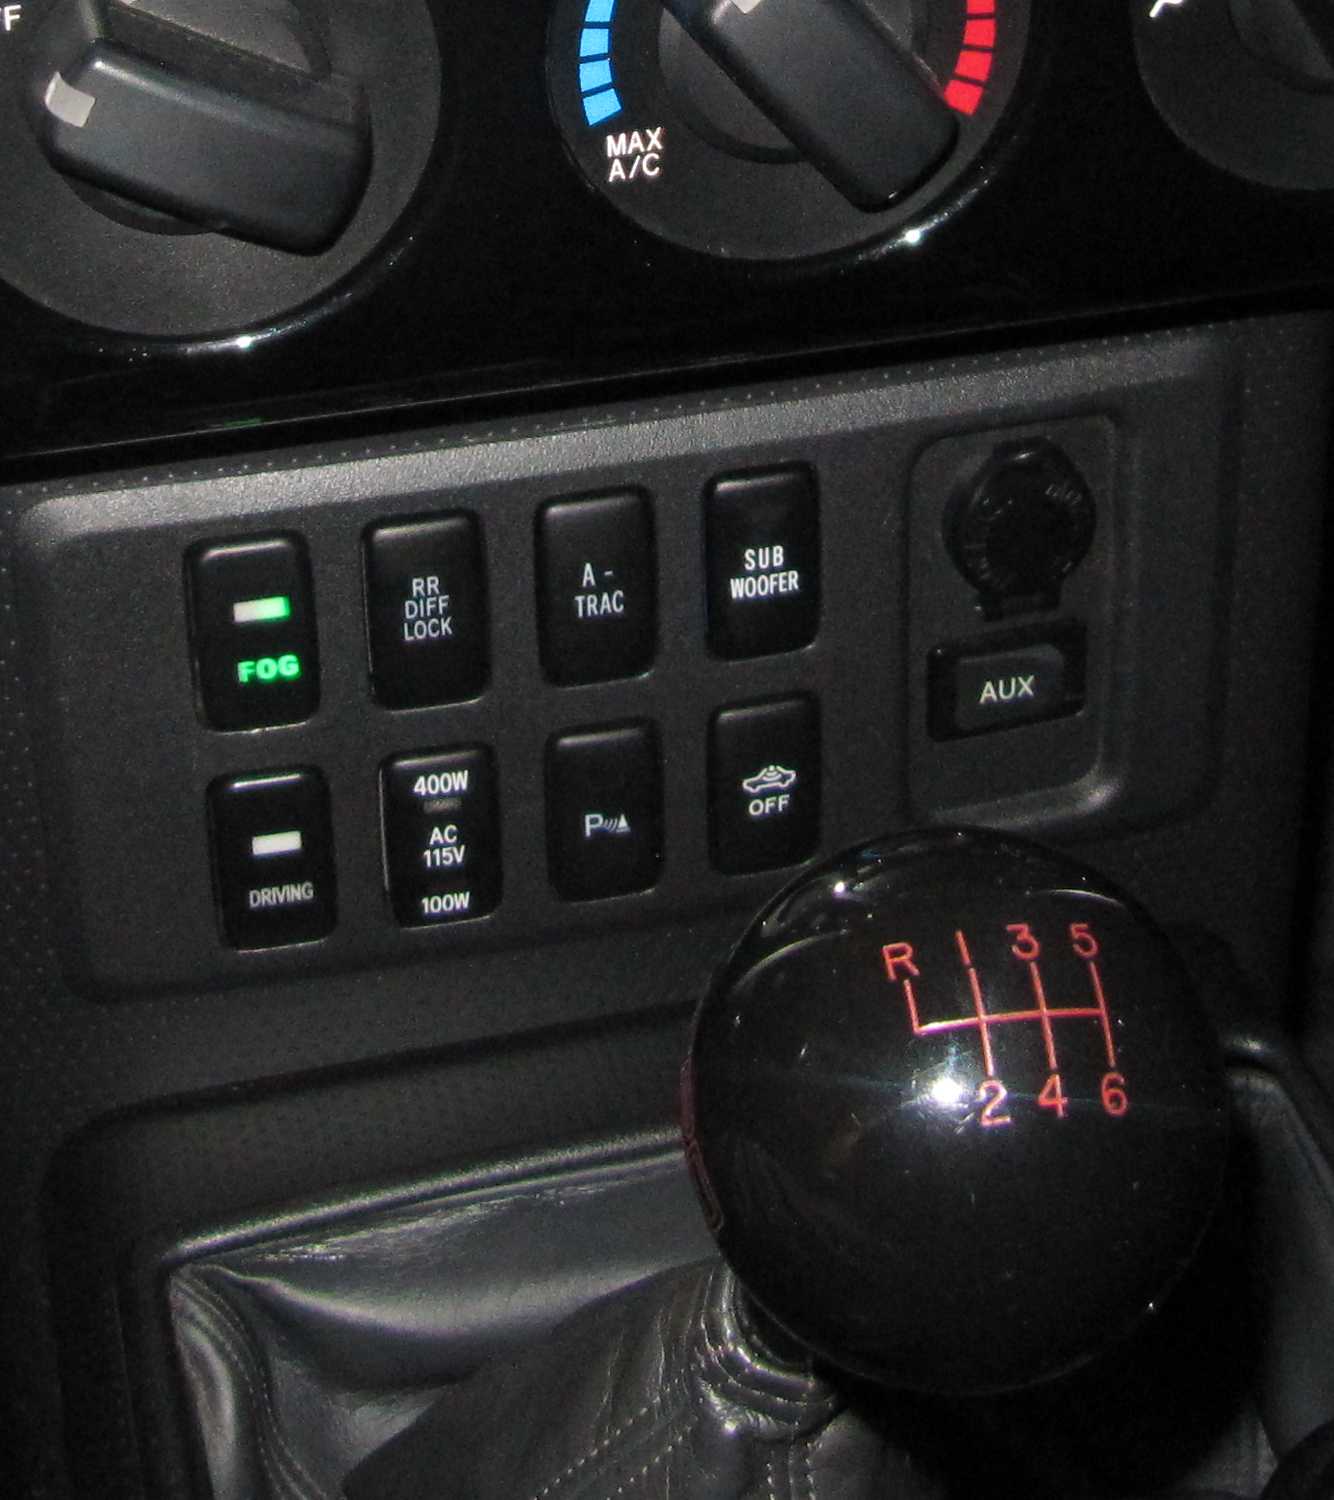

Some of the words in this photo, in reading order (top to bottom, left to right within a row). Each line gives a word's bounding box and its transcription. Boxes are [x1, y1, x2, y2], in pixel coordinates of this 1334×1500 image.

[605, 128, 664, 158] MAX
[607, 152, 661, 182] A/C
[744, 545, 785, 571] SUB
[411, 575, 441, 597] RR
[729, 570, 800, 600] WOOFER
[405, 596, 450, 620] DIFF
[574, 590, 625, 618] TRAC
[404, 616, 453, 642] LOCK
[237, 654, 301, 683] FOG
[979, 675, 1035, 704] AUX
[413, 769, 469, 796] 400W
[748, 793, 790, 817] OFF
[429, 824, 458, 845] AC
[423, 844, 466, 868] 115V
[249, 881, 314, 909] DRIVING
[421, 891, 470, 915] 100W
[881, 941, 920, 981] R
[1005, 923, 1041, 961] 3
[1069, 922, 1099, 959] 5
[978, 1079, 1012, 1128] 2
[1037, 1073, 1069, 1118] 4
[1100, 1071, 1129, 1116] 6
